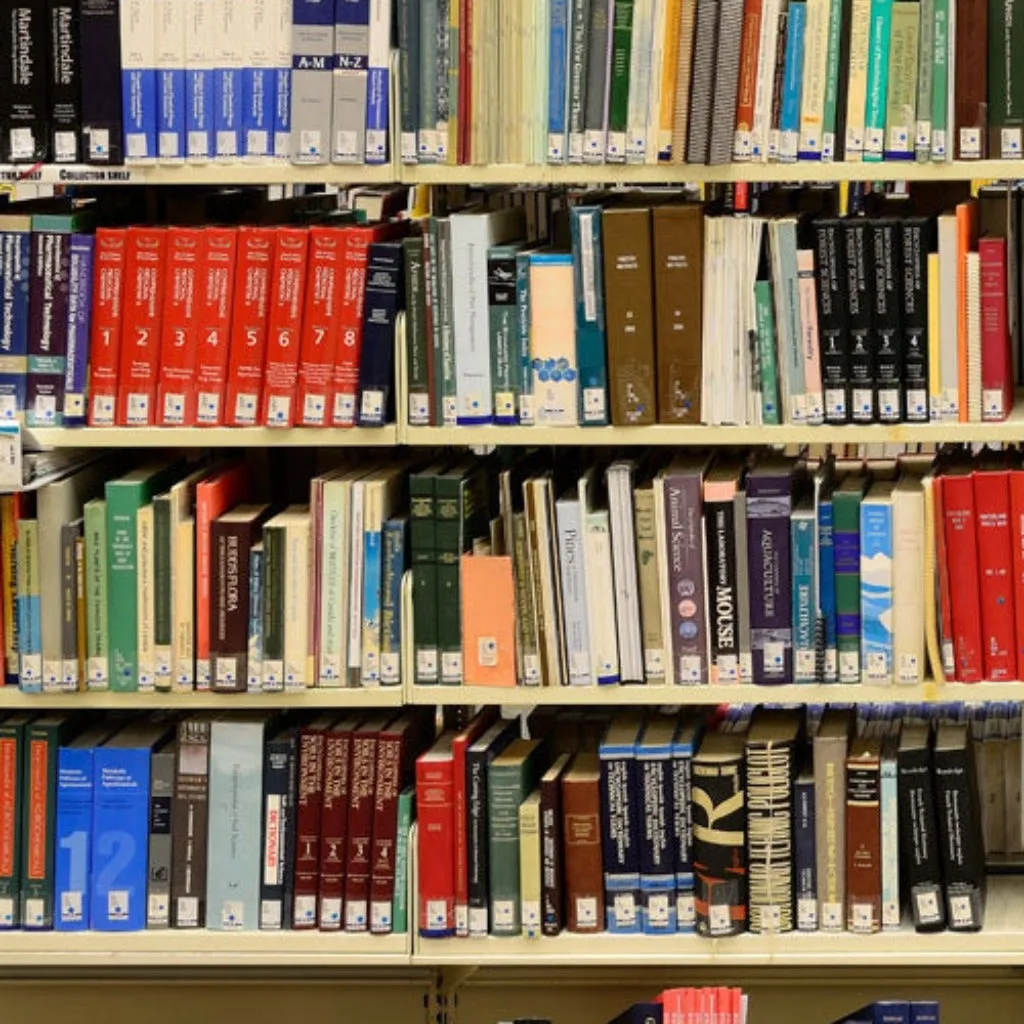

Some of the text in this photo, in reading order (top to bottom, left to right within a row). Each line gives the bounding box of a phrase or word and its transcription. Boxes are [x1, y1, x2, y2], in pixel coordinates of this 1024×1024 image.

[18, 8, 32, 84] Martindale
[60, 6, 73, 84] Martindale
[102, 331, 110, 346] 1
[136, 330, 148, 346] 2
[174, 331, 185, 347] 3
[206, 331, 219, 347] 4
[246, 331, 257, 346] 5
[279, 331, 289, 347] 6
[314, 330, 325, 345] 7
[344, 331, 355, 347] 8
[716, 586, 733, 648] MOUSE
[96, 830, 135, 898] 2
